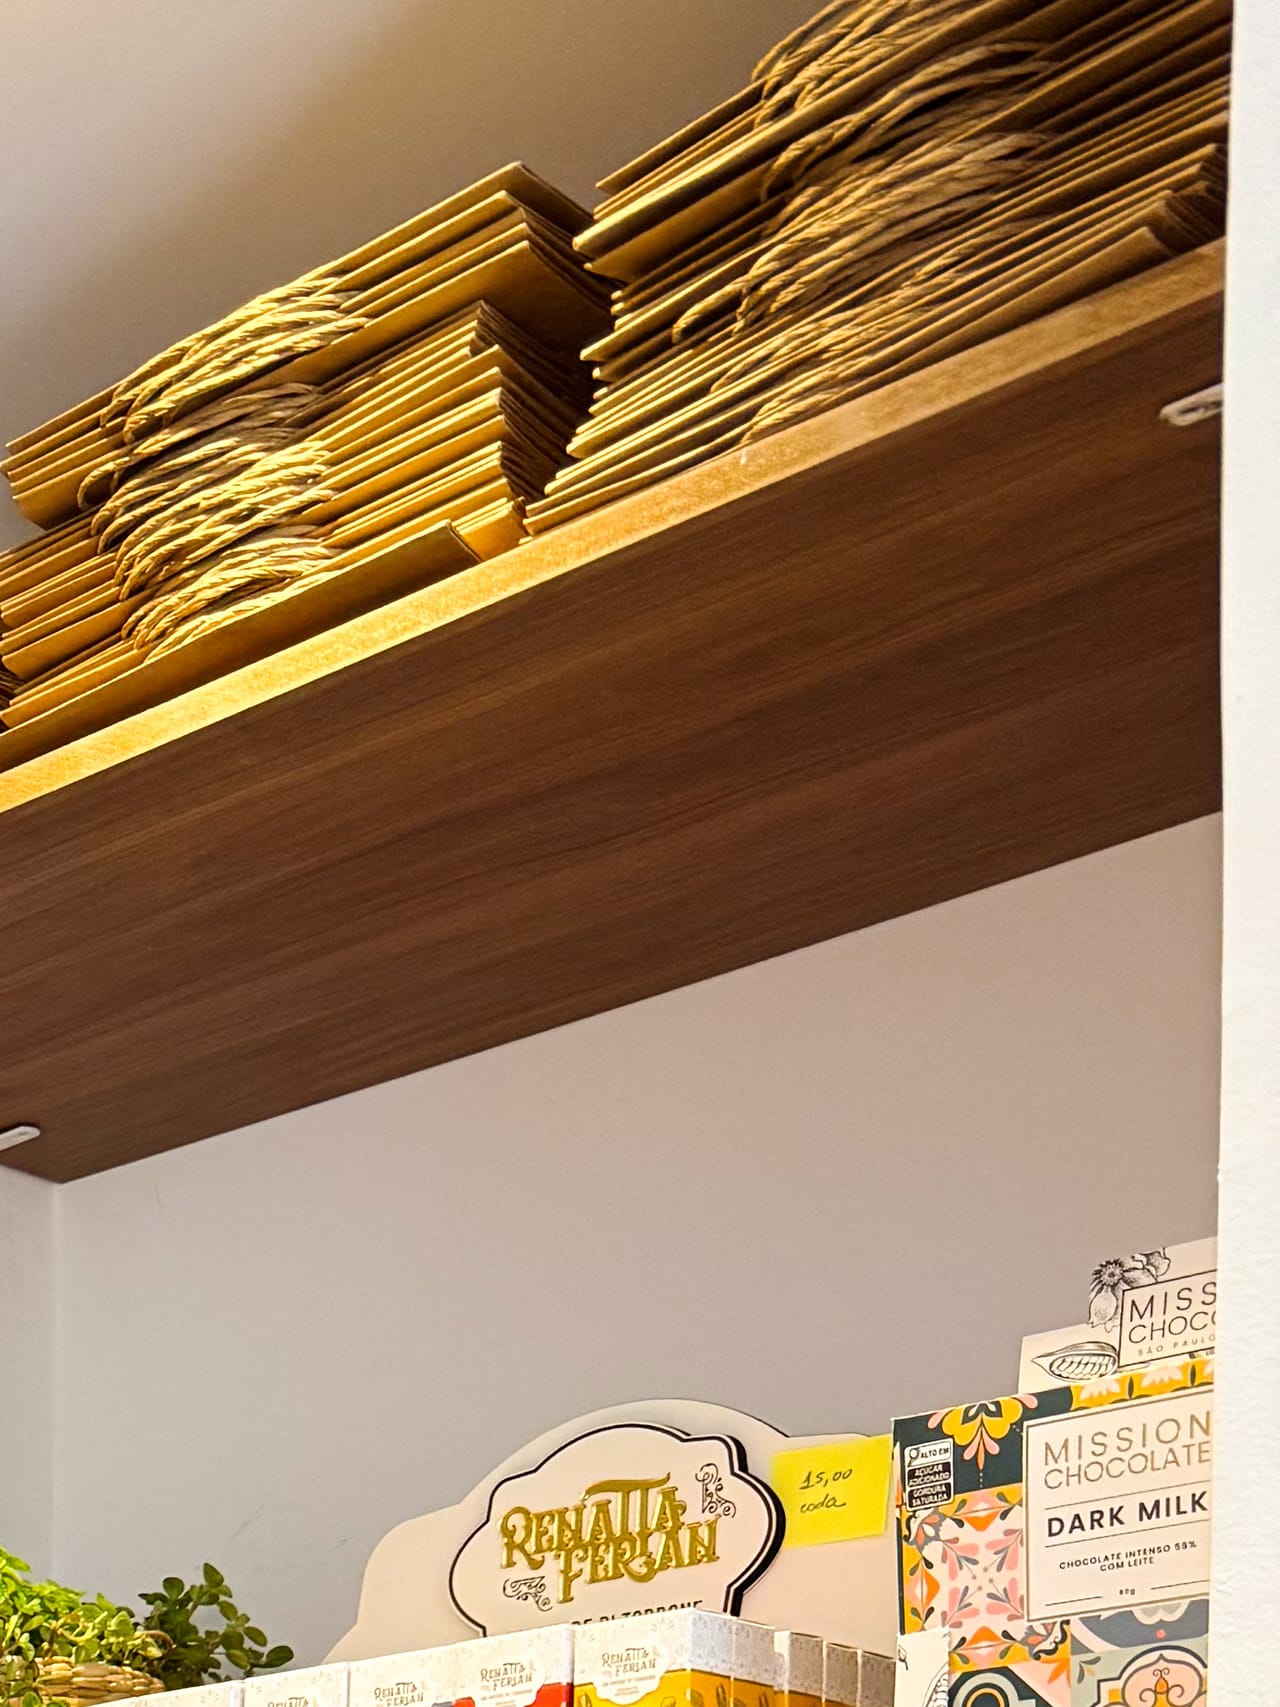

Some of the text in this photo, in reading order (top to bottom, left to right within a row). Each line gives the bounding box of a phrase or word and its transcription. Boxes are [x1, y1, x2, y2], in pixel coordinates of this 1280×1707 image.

[1044, 1411, 1211, 1466] MISSION
[1044, 1442, 1211, 1490] CHOCOLATE
[499, 1472, 687, 1570] RENATTA
[1048, 1491, 1208, 1531] DARK MILK
[1100, 1557, 1154, 1572] COM LEITE
